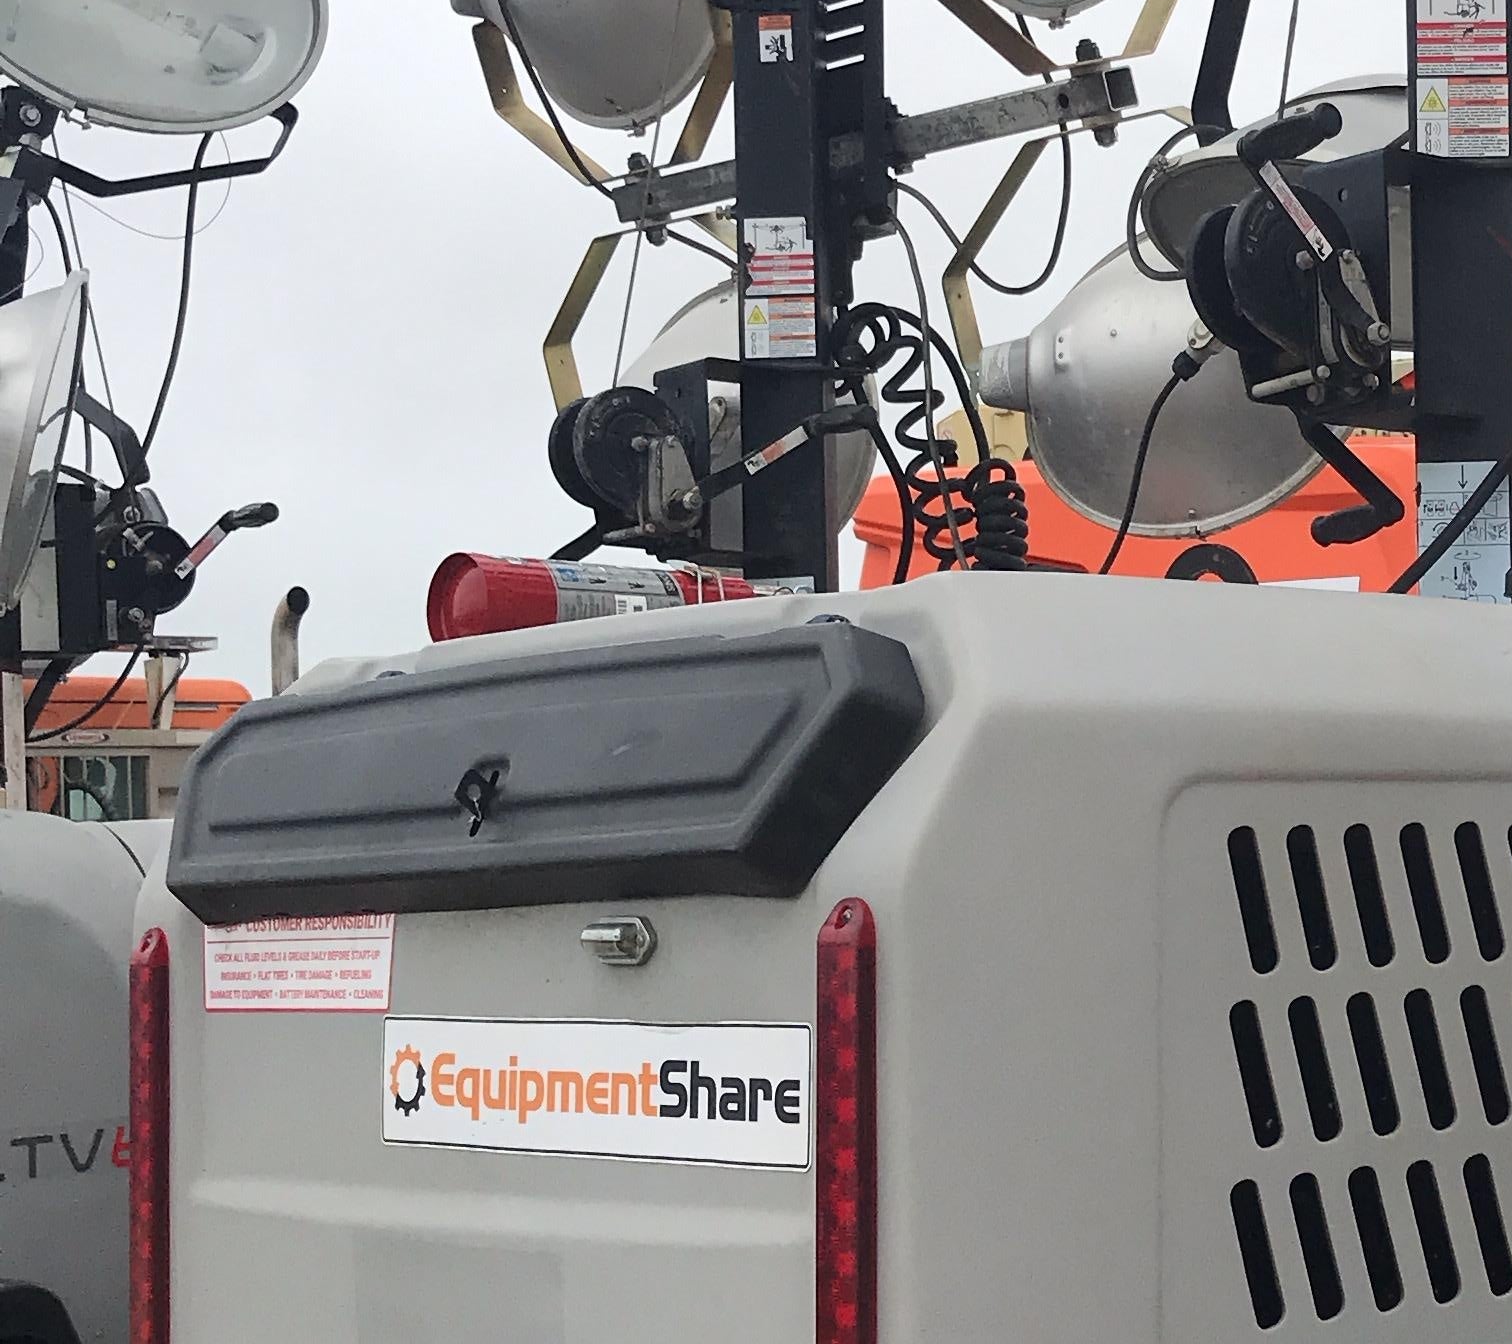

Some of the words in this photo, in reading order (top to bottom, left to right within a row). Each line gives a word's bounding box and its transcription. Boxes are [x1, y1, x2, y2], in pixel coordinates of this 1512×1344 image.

[246, 917, 300, 932] CUSTOMER
[305, 914, 391, 931] RESPONSIBILITY
[431, 1052, 801, 1125] EquipmentShare
[0, 1126, 131, 1181] TV6
